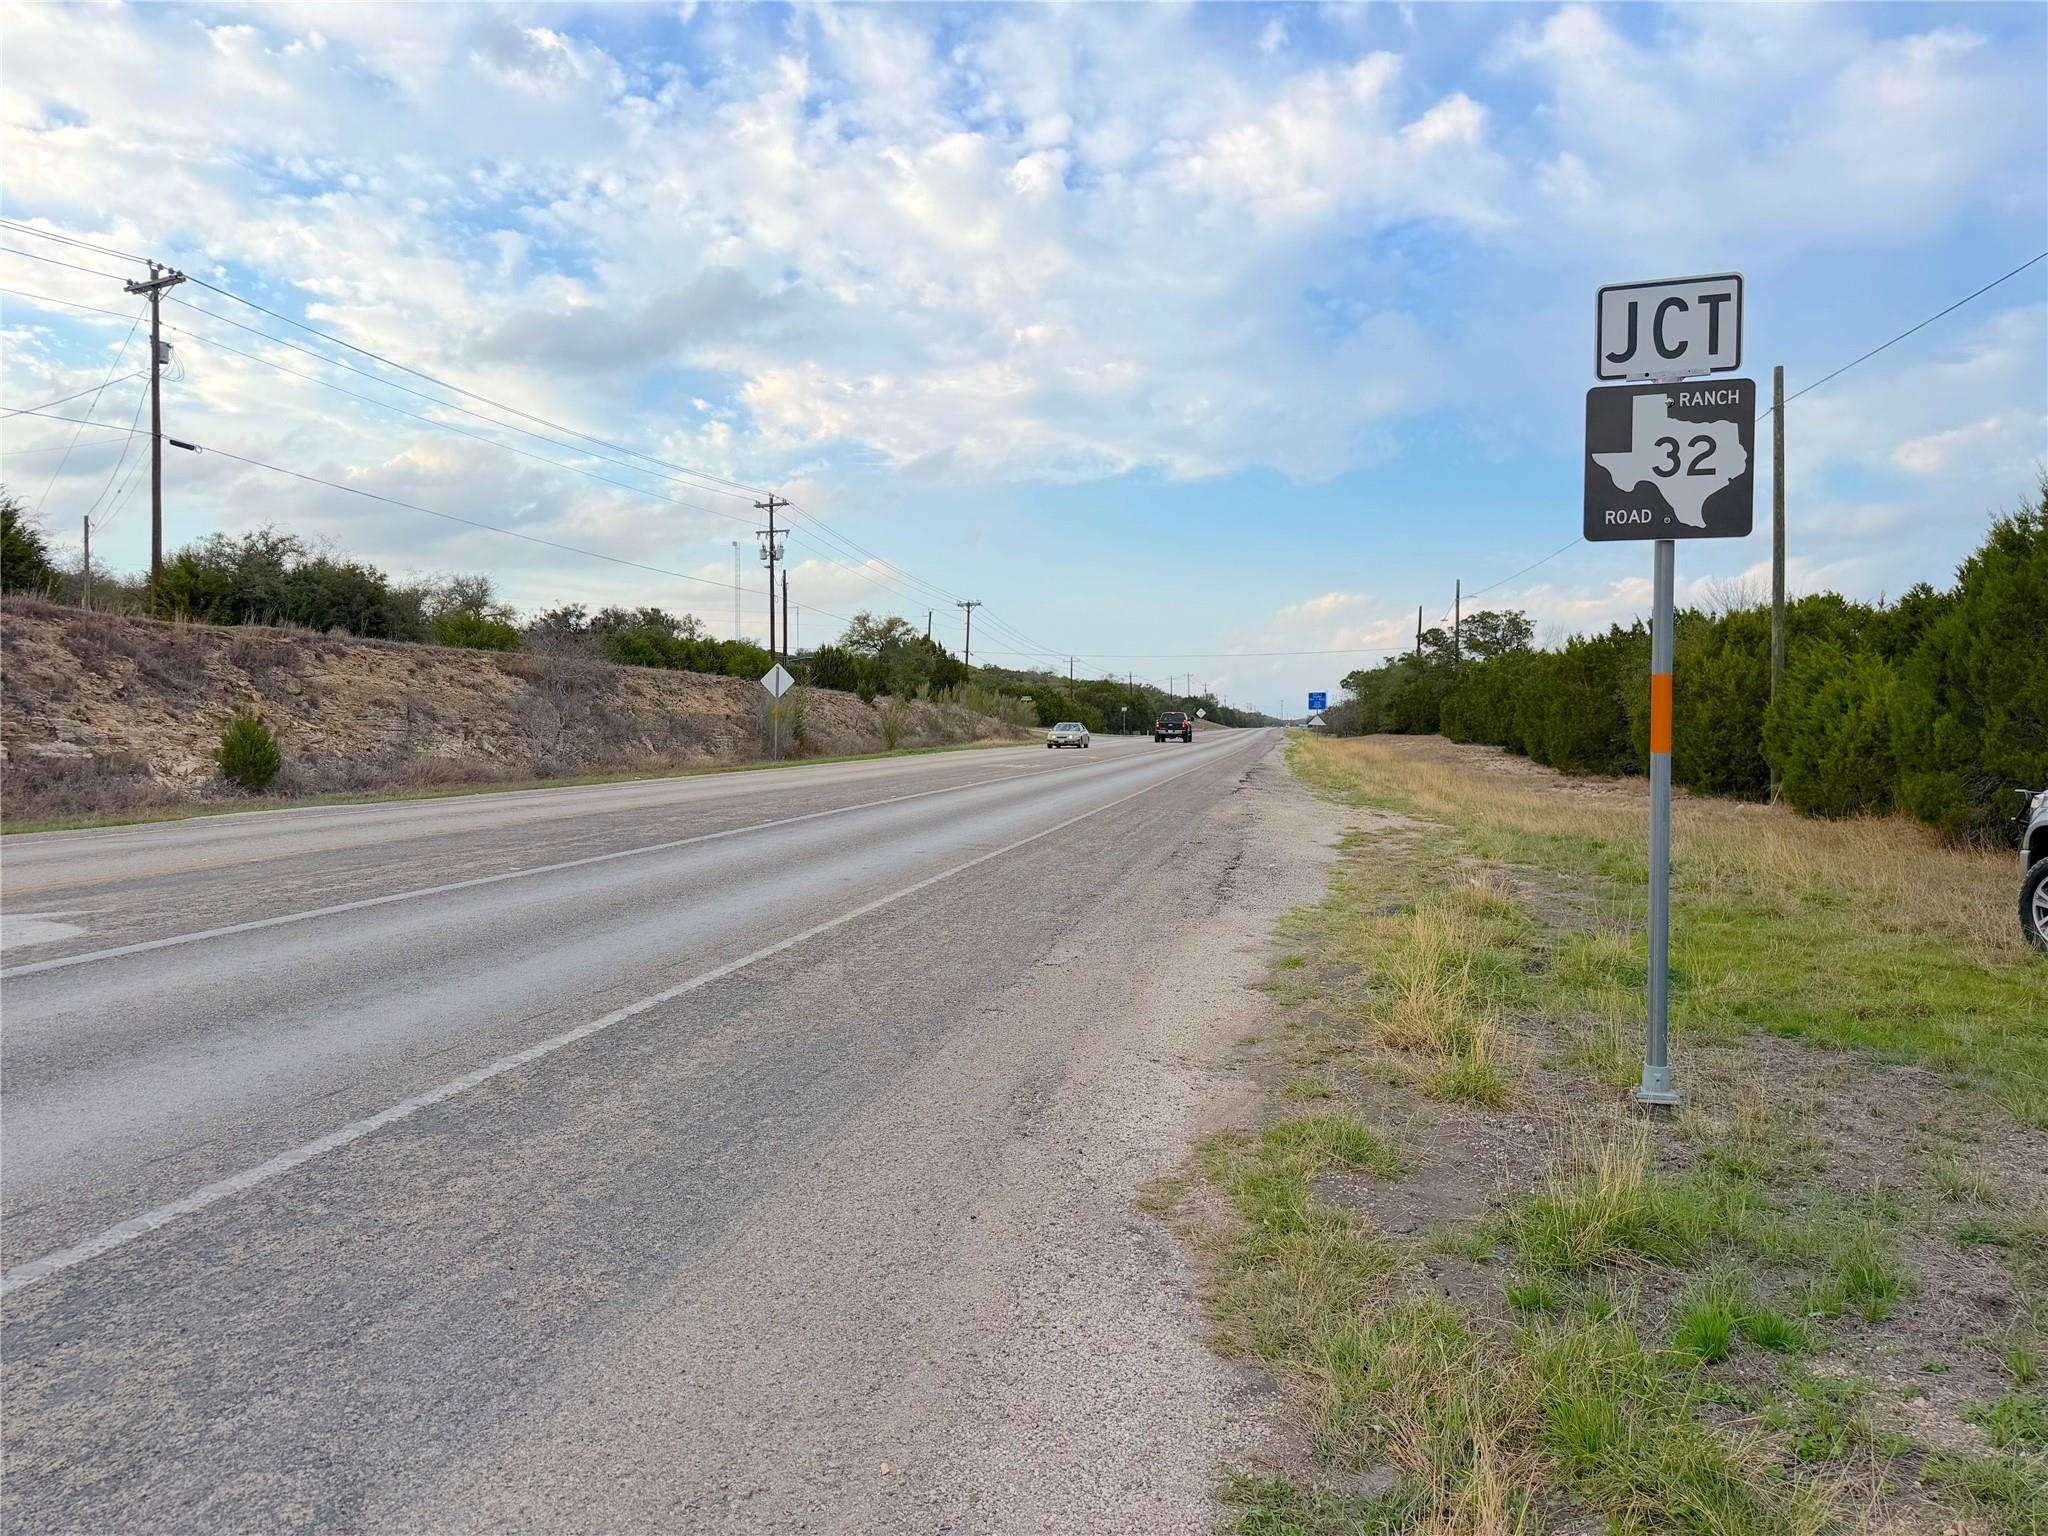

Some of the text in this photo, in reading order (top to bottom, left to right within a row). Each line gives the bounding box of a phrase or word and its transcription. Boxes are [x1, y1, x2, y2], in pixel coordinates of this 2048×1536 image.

[1605, 293, 1732, 364] JCT
[1679, 389, 1740, 407] RANCH
[1652, 435, 1717, 478] 32
[1605, 509, 1652, 525] ROAD
